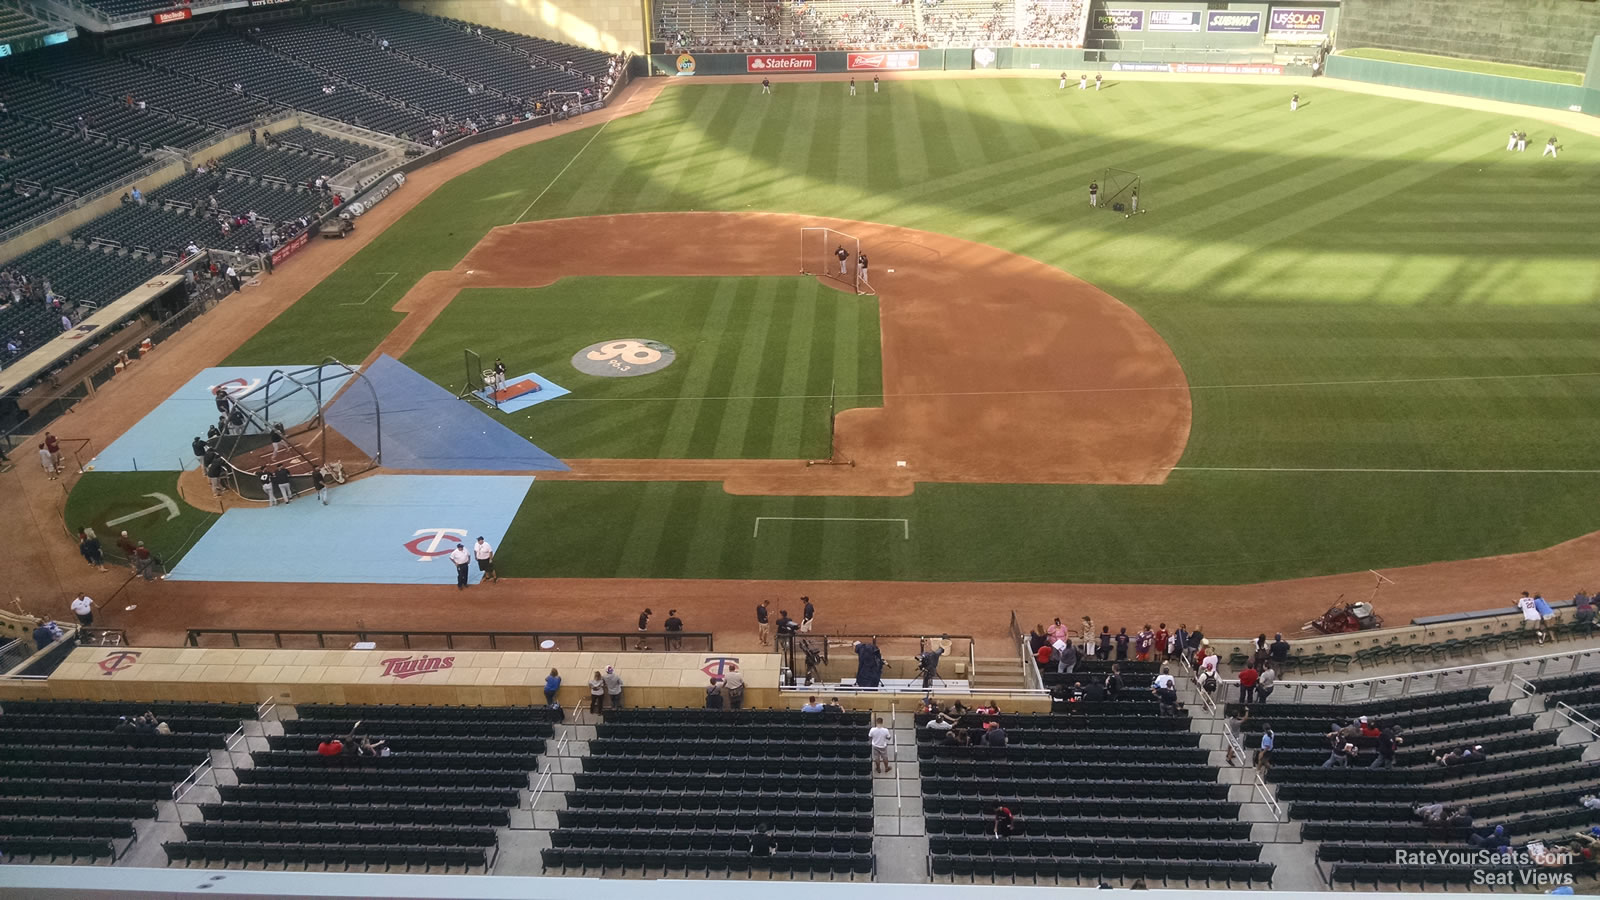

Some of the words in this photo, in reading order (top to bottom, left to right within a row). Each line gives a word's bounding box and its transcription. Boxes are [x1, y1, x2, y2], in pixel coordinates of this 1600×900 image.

[1098, 16, 1138, 24] PISTACHIOS
[1210, 15, 1258, 26] SUBWAY
[587, 341, 662, 365] 96
[608, 360, 631, 372] 96.3
[380, 655, 455, 679] Twins
